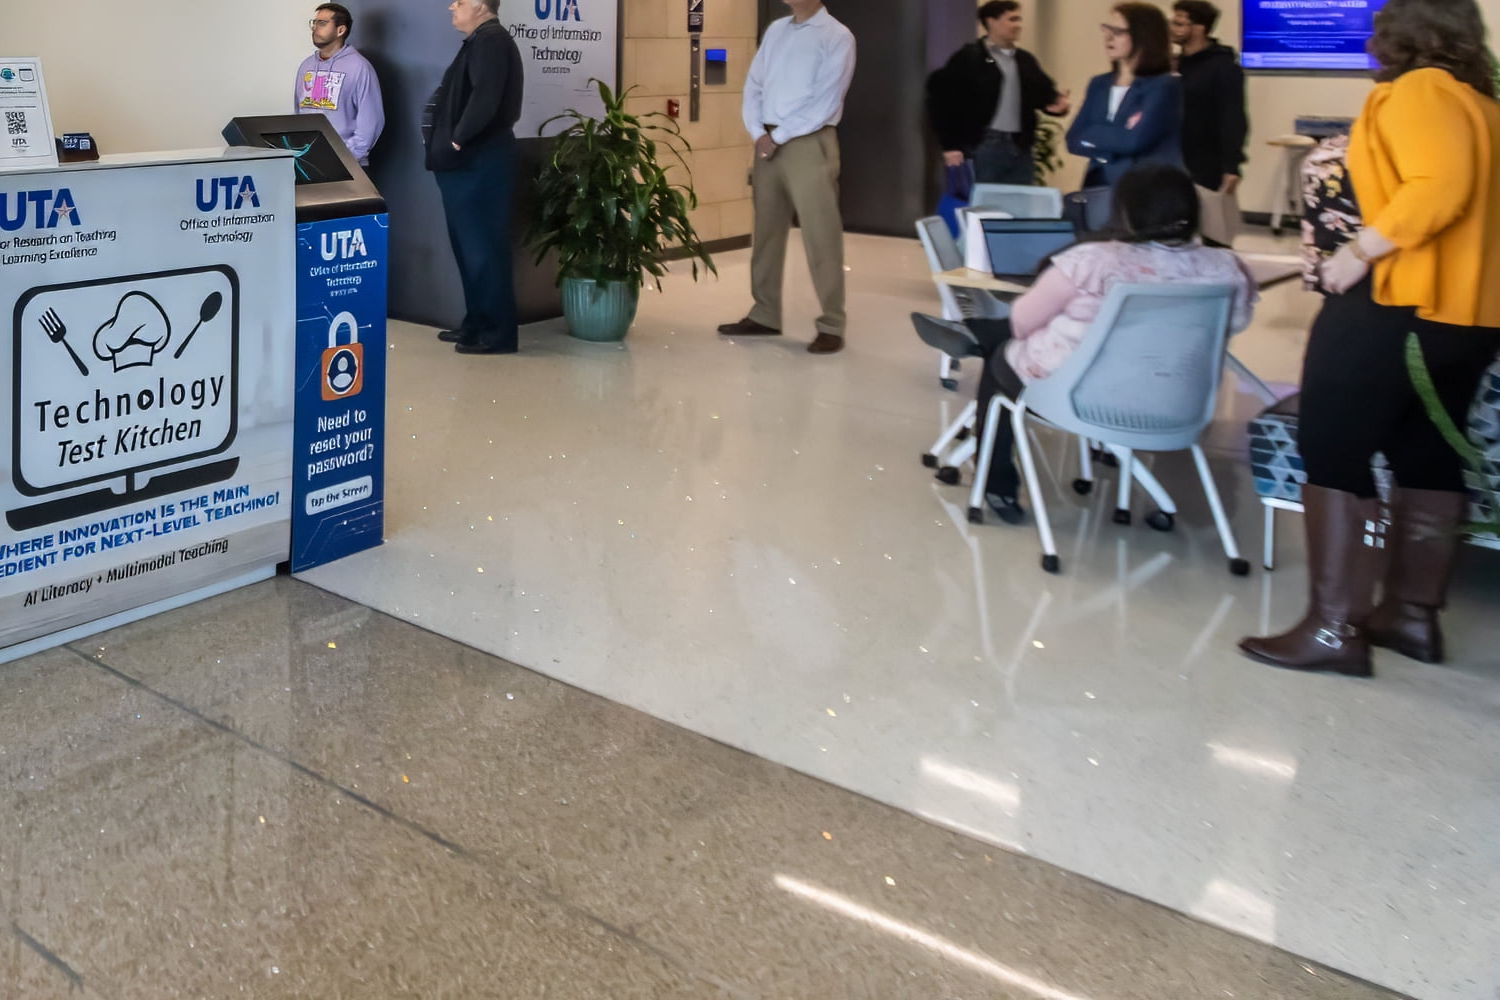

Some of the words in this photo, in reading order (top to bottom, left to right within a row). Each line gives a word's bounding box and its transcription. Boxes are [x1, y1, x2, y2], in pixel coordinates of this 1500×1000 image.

[508, 23, 538, 39] Office
[540, 25, 551, 40] of
[552, 27, 602, 41] Information
[531, 46, 583, 65] Technology
[195, 175, 261, 212] UTA
[180, 218, 209, 230] Office
[211, 216, 221, 228] of
[223, 214, 275, 226] Information
[13, 234, 58, 248] Research
[60, 235, 73, 244] on
[75, 229, 117, 242] Teaching
[203, 230, 254, 243] Technology
[321, 228, 367, 260] UTA
[2, 253, 47, 265] Learning
[50, 246, 98, 260] Excellence
[34, 375, 224, 432] Technology
[317, 409, 350, 433] Need
[354, 409, 367, 423] to
[58, 434, 108, 467] Test
[114, 417, 202, 455] Kitchen
[310, 434, 341, 455] reset
[344, 428, 373, 450] your
[307, 443, 374, 481] password?
[326, 493, 340, 503] the
[342, 485, 368, 498] Screen
[59, 508, 157, 545] INNOVATION
[161, 504, 175, 518] IS
[180, 495, 209, 513] THE
[213, 485, 250, 504] MAIN
[63, 541, 96, 561] FOR
[100, 514, 201, 551] NEXT-LEVEL
[204, 491, 280, 522] TEACHING!
[23, 591, 38, 607] AI
[41, 577, 93, 603] Literacy
[106, 551, 176, 583] Multimodal
[179, 538, 229, 562] Teaching
